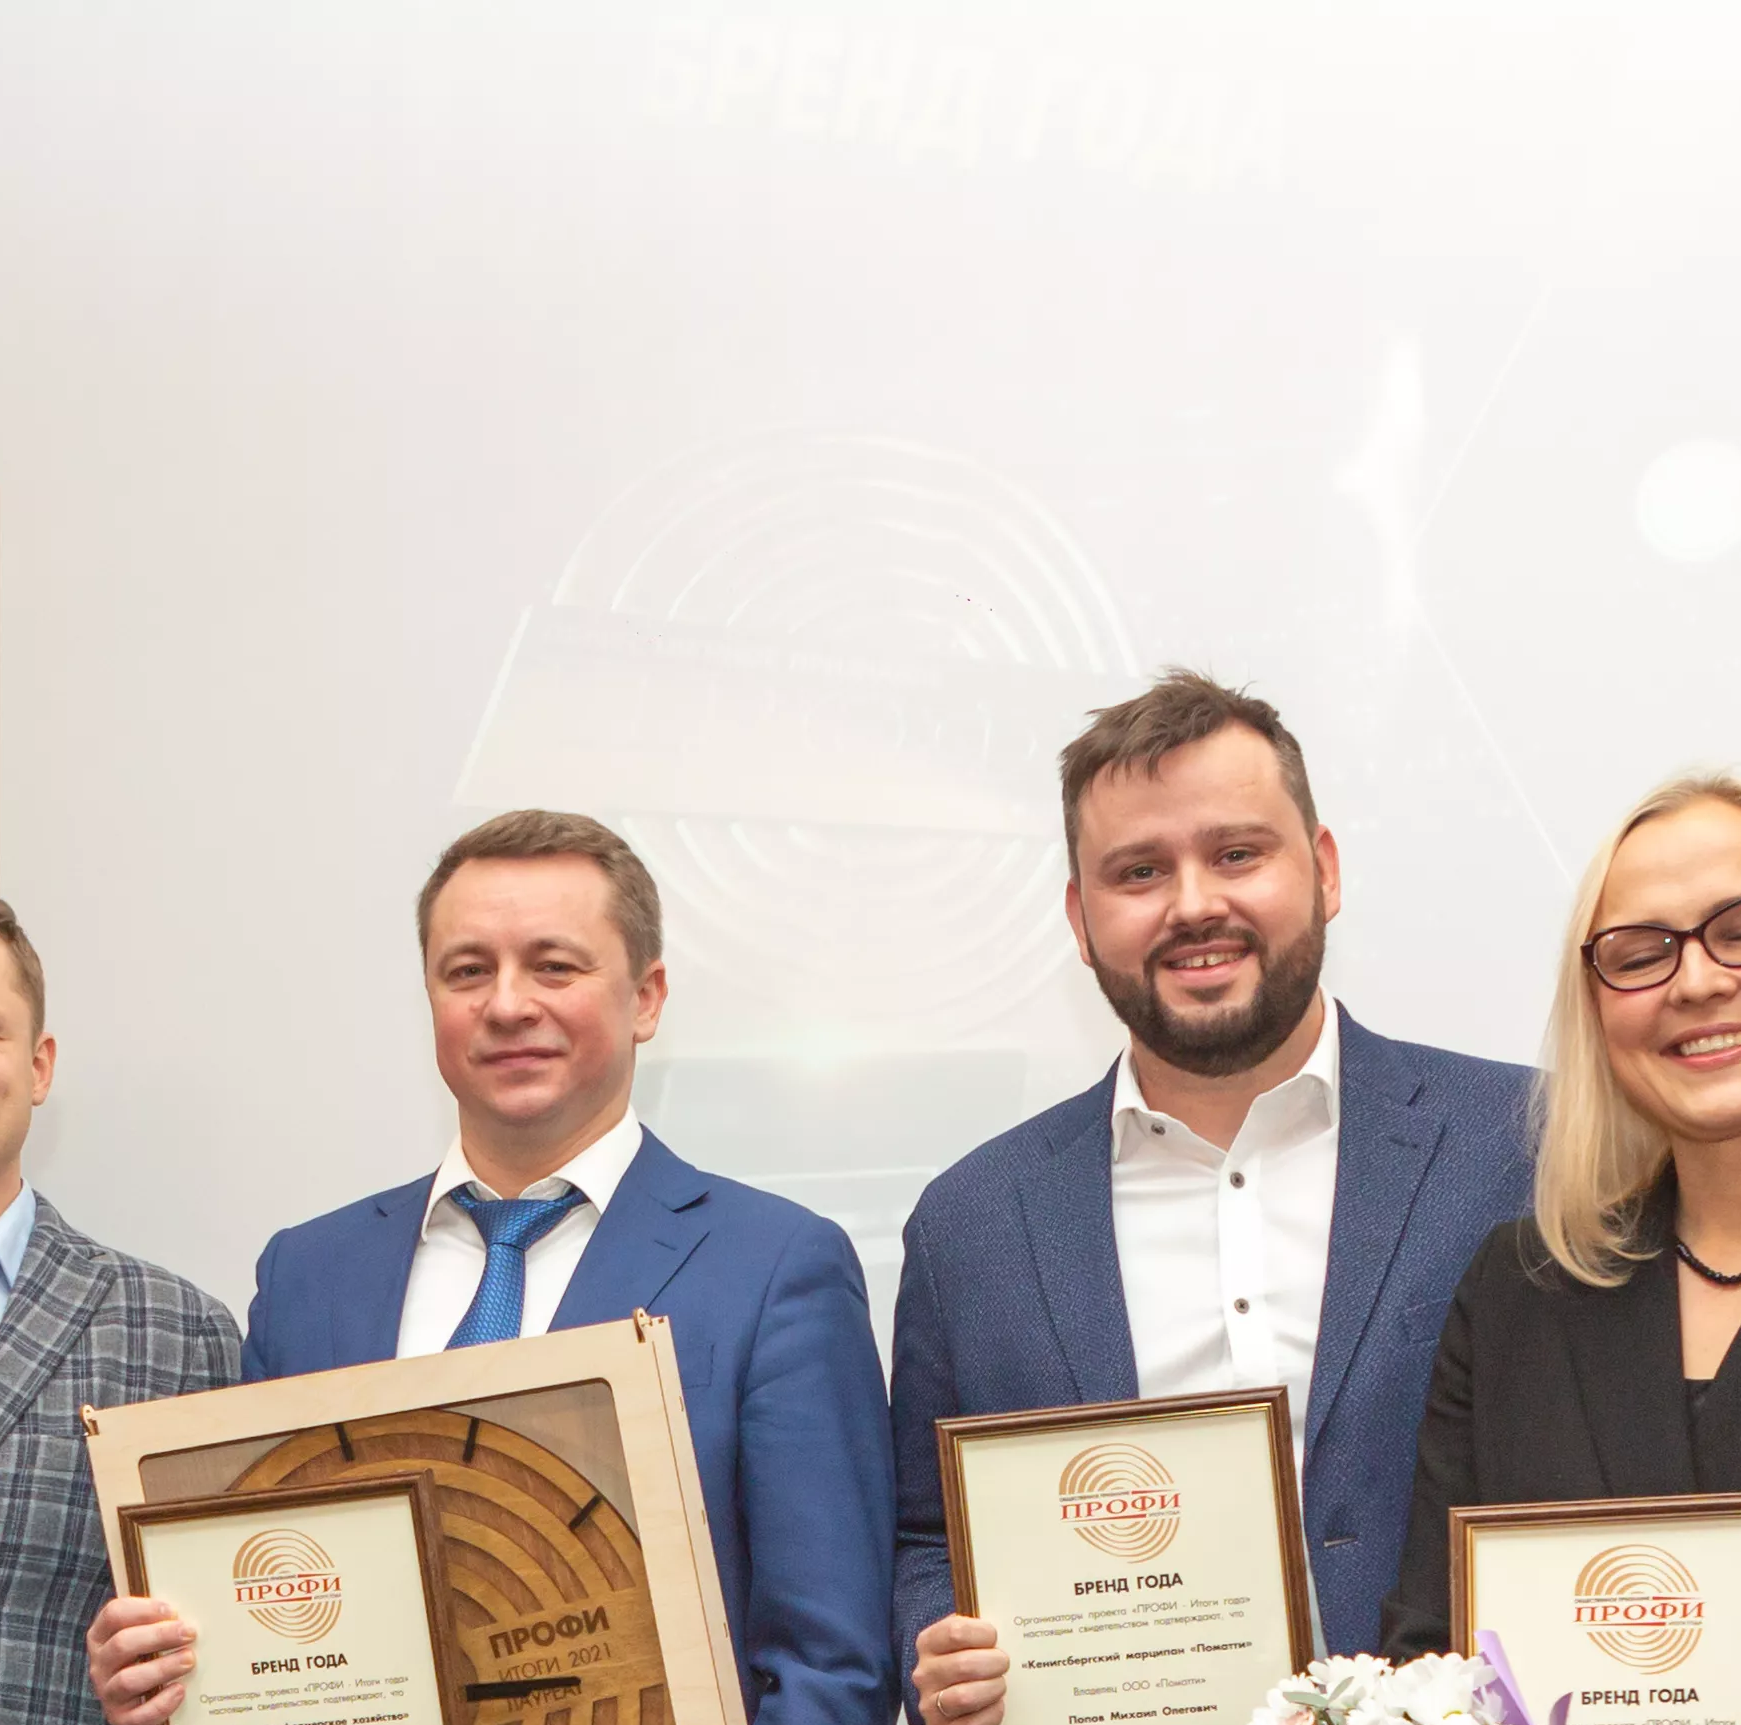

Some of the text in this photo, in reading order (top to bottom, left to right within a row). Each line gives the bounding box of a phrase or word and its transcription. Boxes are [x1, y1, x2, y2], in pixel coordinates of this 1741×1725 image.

[1061, 1492, 1180, 1519] ПРОФИ
[235, 1576, 341, 1602] ПРОФИ
[1073, 1572, 1183, 1595] БРЕНД ГОДА
[1574, 1601, 1704, 1622] ПРОФИ
[488, 1605, 610, 1659] ПРОФИ
[250, 1652, 348, 1675] БРЕНД ГОДА
[498, 1642, 612, 1681] ИТОГИ 2021
[1021, 1641, 1252, 1669] «Кенигсбергский марципан «Поматти»
[1581, 1687, 1699, 1706] БРЕНД ГОДА
[352, 1712, 409, 1724] хозяйство»
[1068, 1704, 1217, 1724] Попов Михаил Олегович
